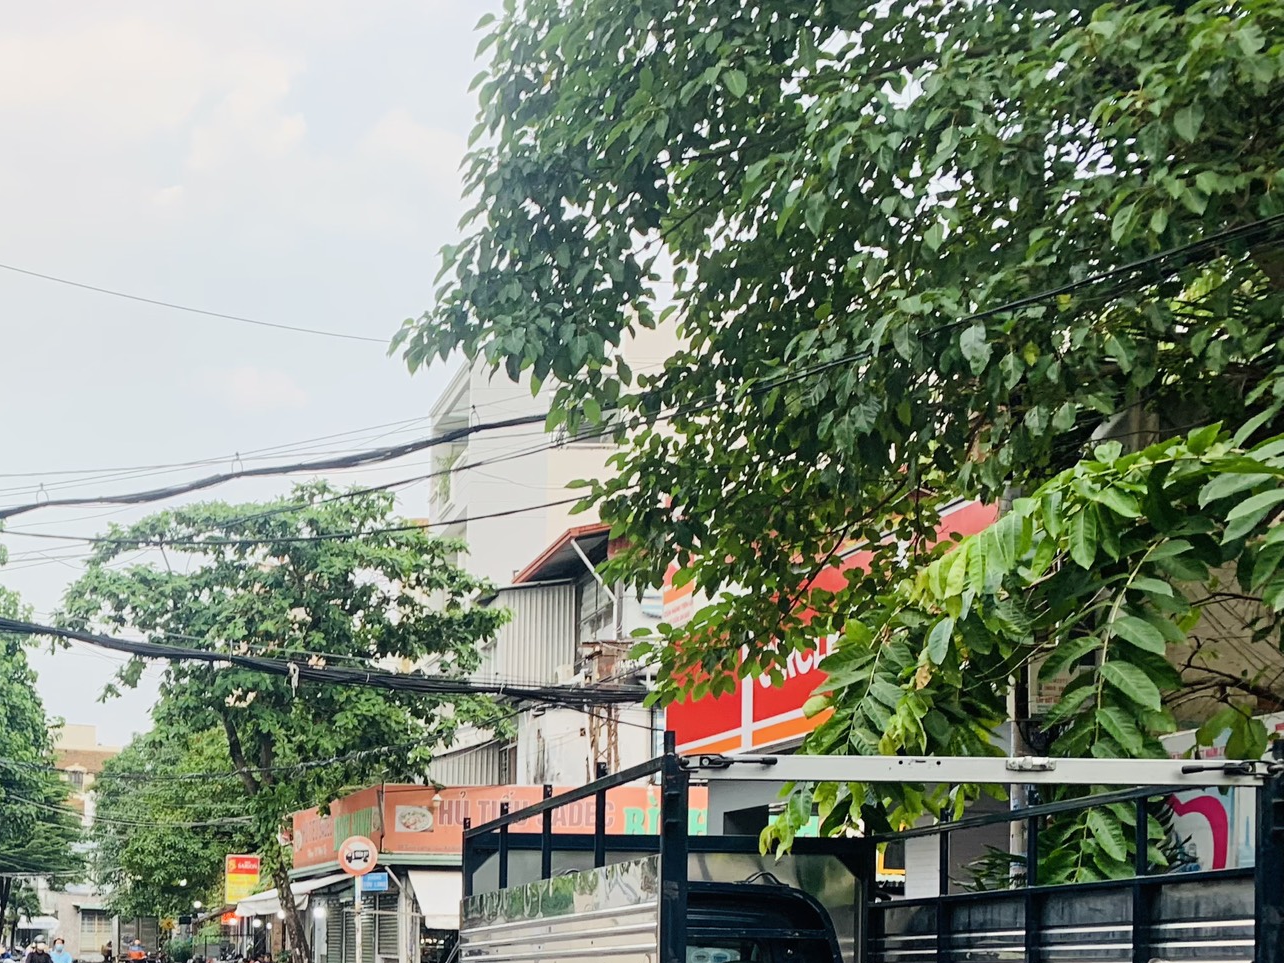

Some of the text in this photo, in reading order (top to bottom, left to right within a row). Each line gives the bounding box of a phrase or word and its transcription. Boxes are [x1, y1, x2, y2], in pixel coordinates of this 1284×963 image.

[438, 790, 466, 827] HỦ
[477, 791, 529, 829] TIU
[537, 800, 615, 829] ADEC
